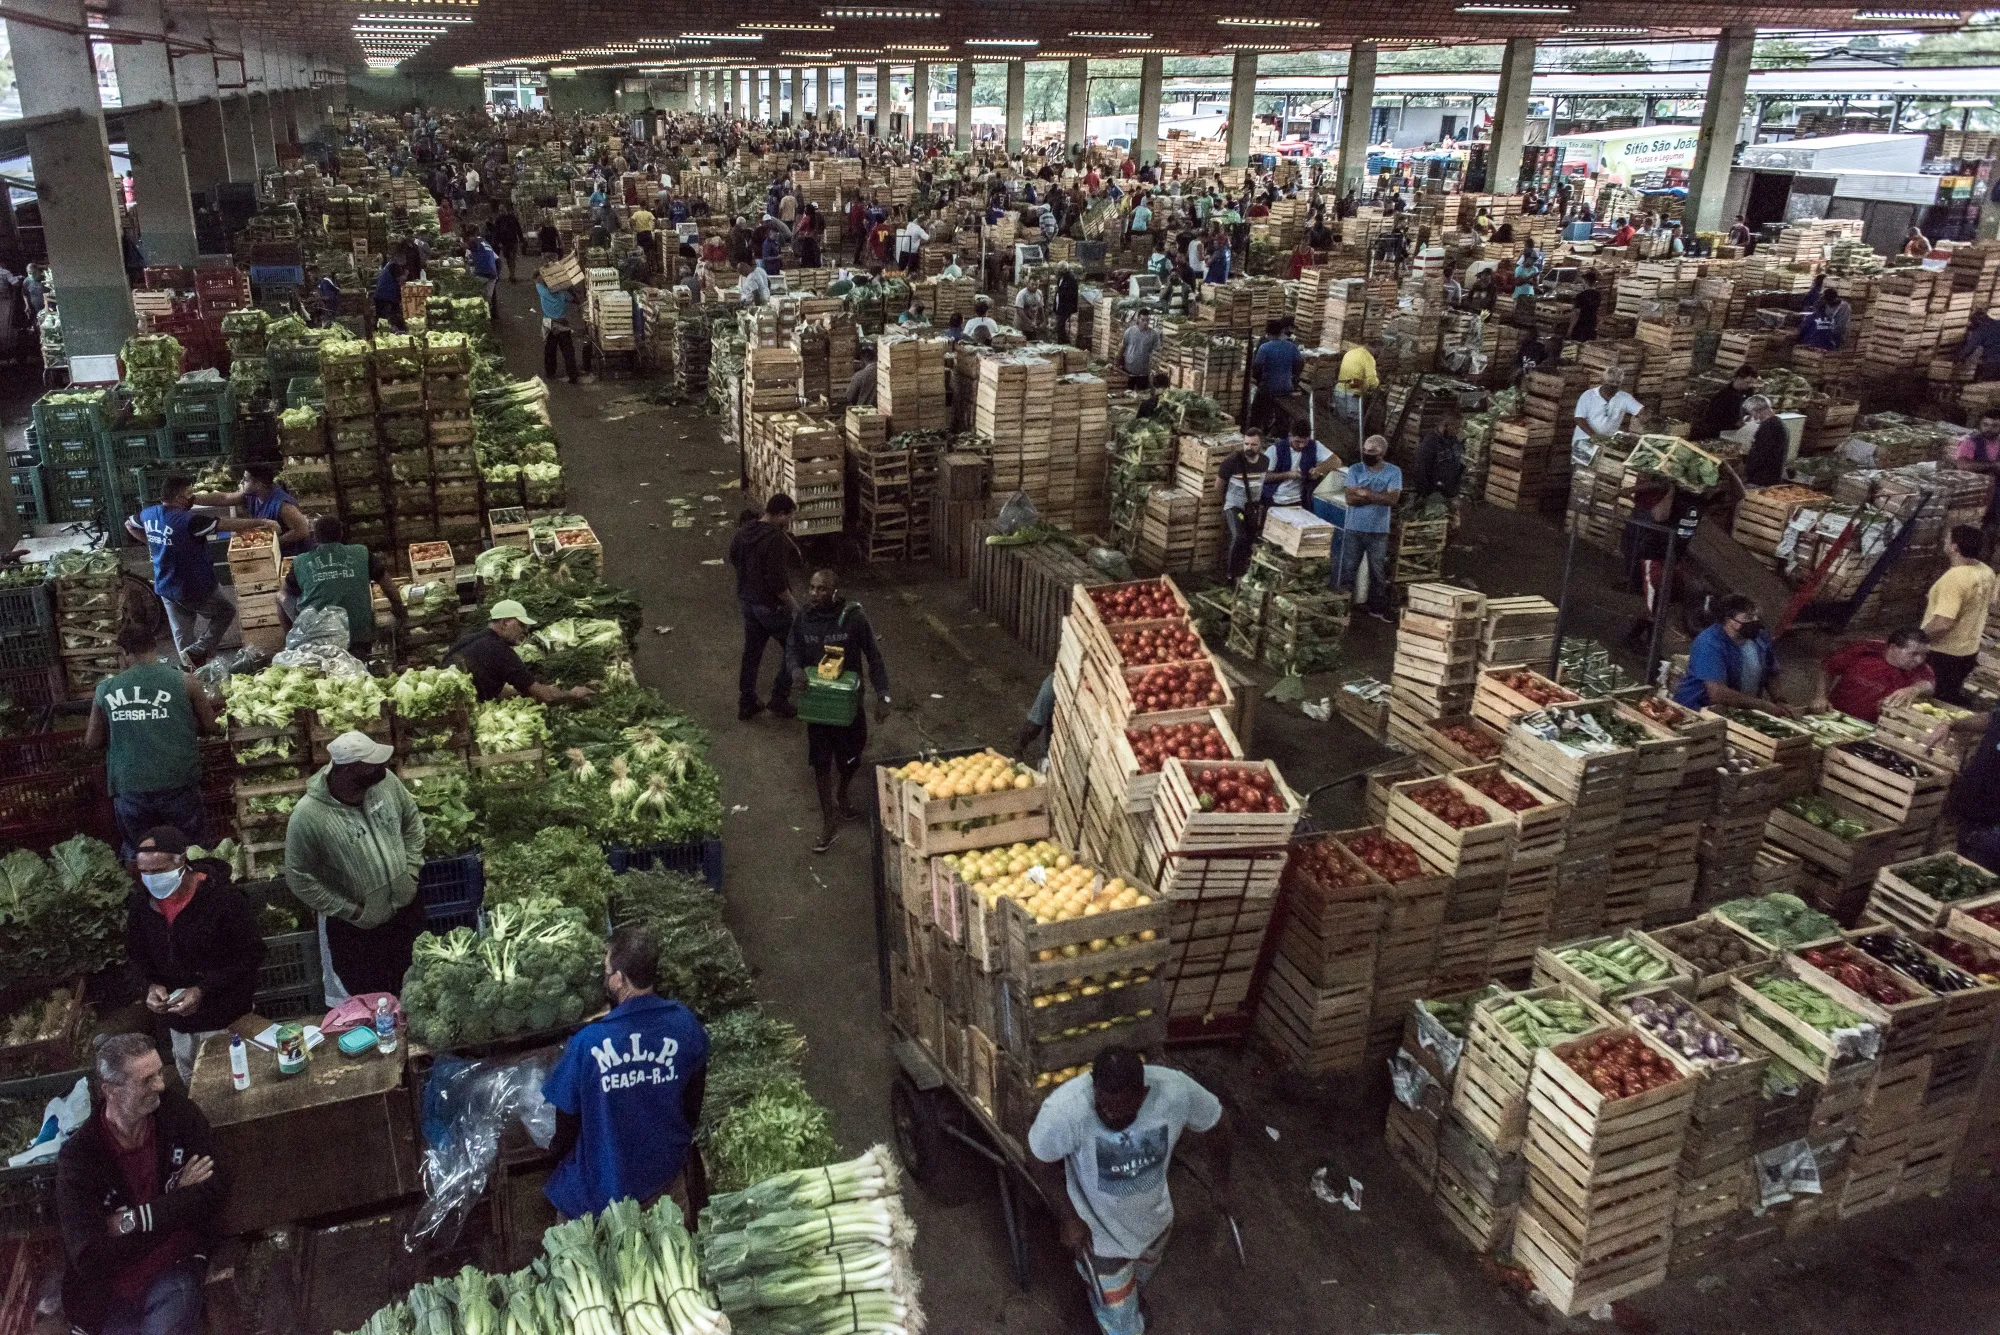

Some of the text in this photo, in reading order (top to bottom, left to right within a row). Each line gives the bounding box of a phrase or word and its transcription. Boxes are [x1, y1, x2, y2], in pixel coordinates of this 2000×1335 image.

[1651, 140, 1671, 152] São
[1673, 137, 1698, 150] João
[1635, 156, 1653, 164] Frutas
[1660, 152, 1685, 162] Legumes
[111, 707, 170, 722] CEASA-R.J.
[590, 1033, 679, 1074] M.L.P.
[601, 1065, 679, 1093] CEASA-R.J.
